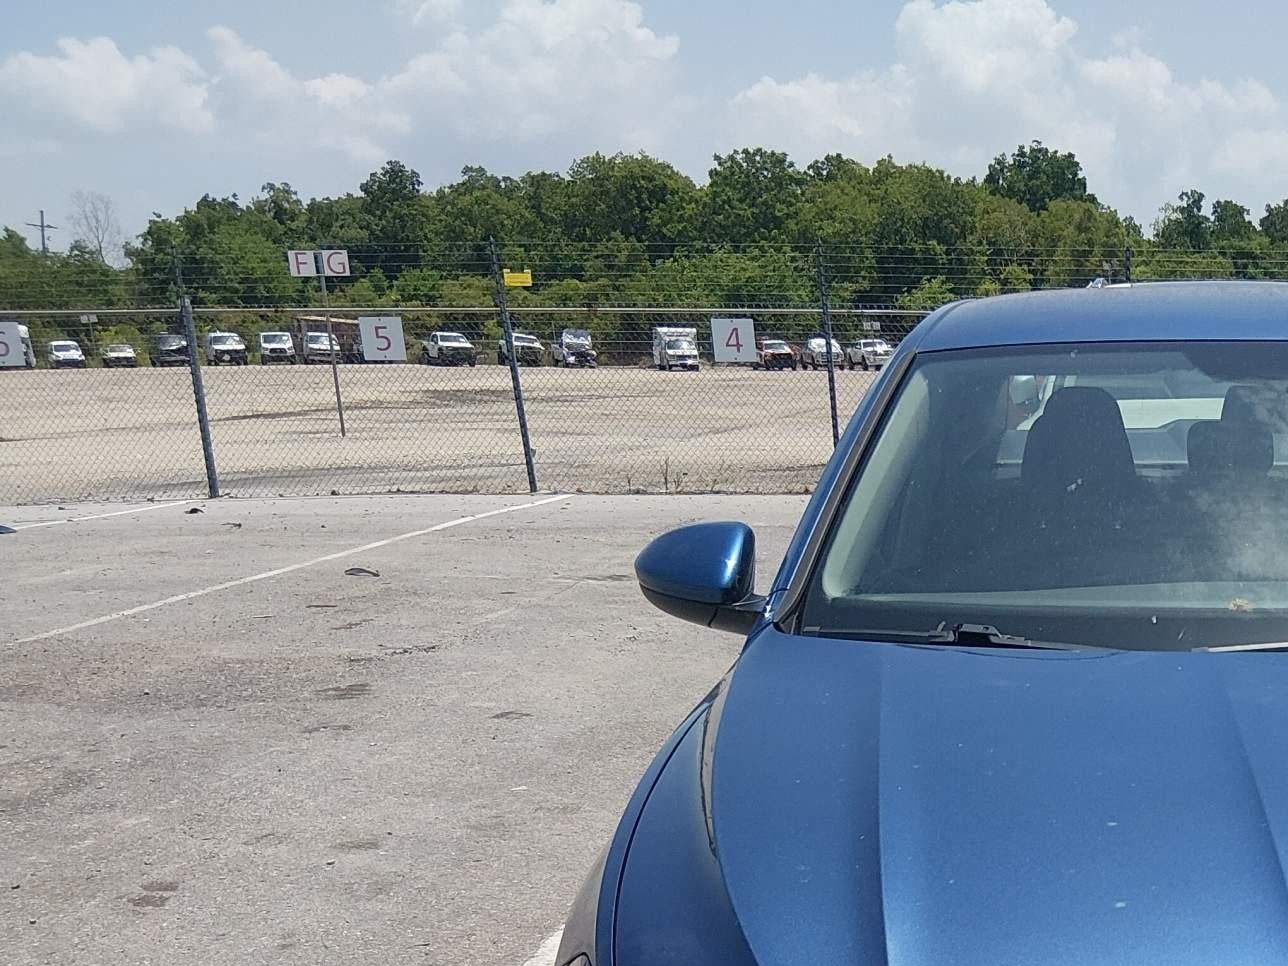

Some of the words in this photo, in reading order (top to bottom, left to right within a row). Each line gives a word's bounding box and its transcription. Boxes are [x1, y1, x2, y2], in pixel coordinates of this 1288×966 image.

[294, 252, 308, 275] F
[327, 251, 347, 275] G
[374, 326, 392, 352] 5
[725, 327, 744, 353] 4
